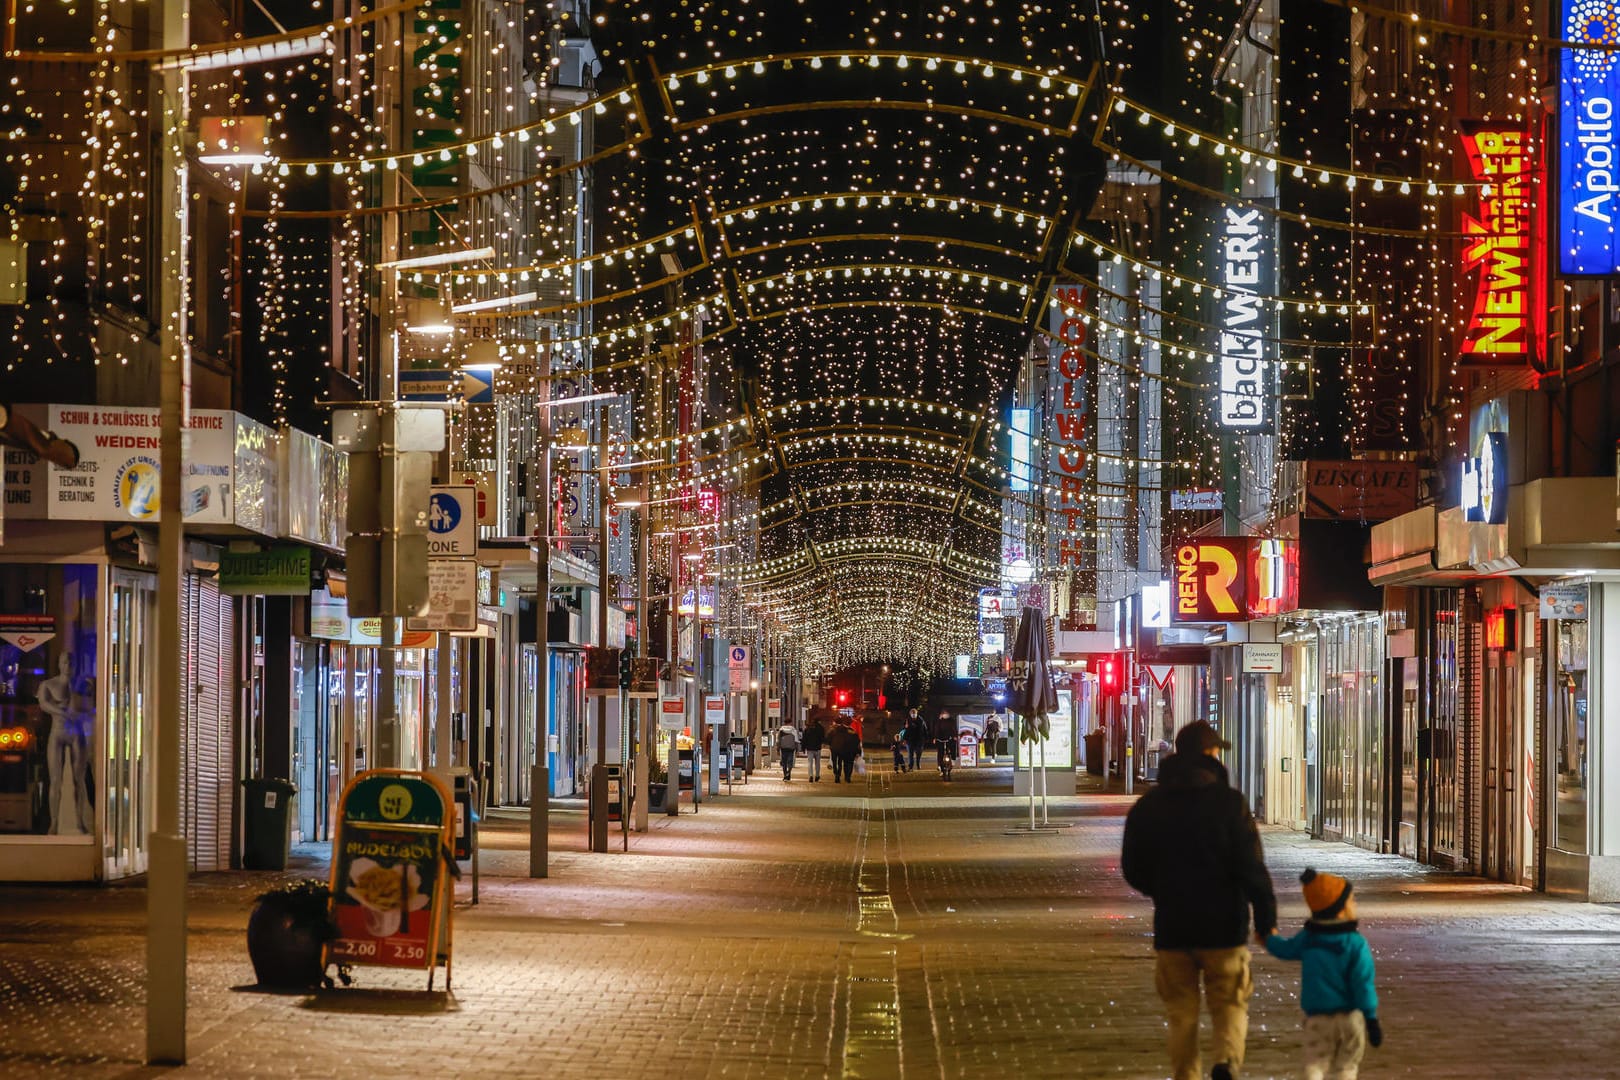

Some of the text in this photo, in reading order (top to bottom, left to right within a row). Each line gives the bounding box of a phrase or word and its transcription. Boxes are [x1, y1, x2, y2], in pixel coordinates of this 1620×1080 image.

[1577, 97, 1619, 224] Apollo
[60, 411, 89, 425] SCHUH
[92, 412, 99, 426] &
[101, 410, 148, 427] SCHLÜSSEL
[151, 414, 162, 427] SC
[1056, 288, 1088, 567] WOOLWORTH
[95, 435, 162, 449] WEIDEN
[59, 475, 88, 487] TECHNIK
[59, 490, 95, 502] BERATUNG
[1178, 545, 1198, 613] RENO
[1199, 545, 1239, 613] R
[346, 942, 425, 960] 2,00 2,50
